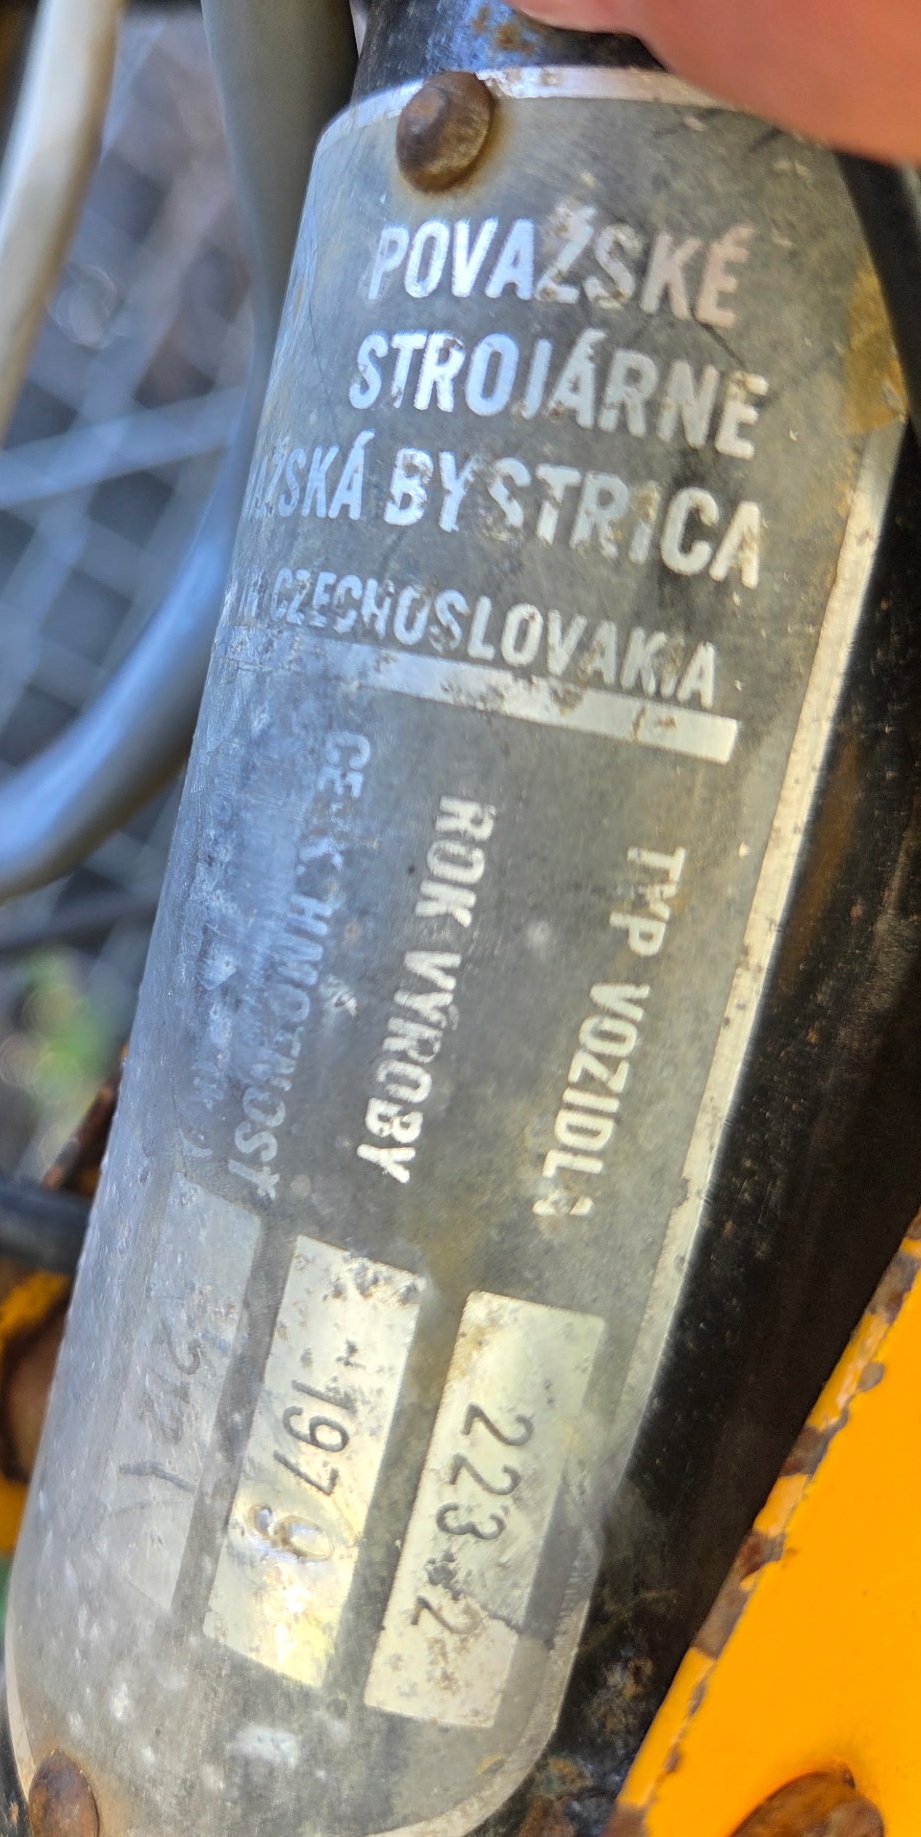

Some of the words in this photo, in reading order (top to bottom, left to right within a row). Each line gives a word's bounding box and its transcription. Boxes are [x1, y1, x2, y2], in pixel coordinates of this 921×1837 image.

[366, 201, 755, 328] POVAŽSKÉ
[348, 328, 770, 460] STROJÁRNE
[383, 446, 762, 590] BYSTRICA
[269, 566, 717, 709] CZECHOSLOVAKIA
[414, 796, 496, 928] ROK
[609, 846, 688, 957] TYP
[357, 950, 463, 1185] VÝROBY
